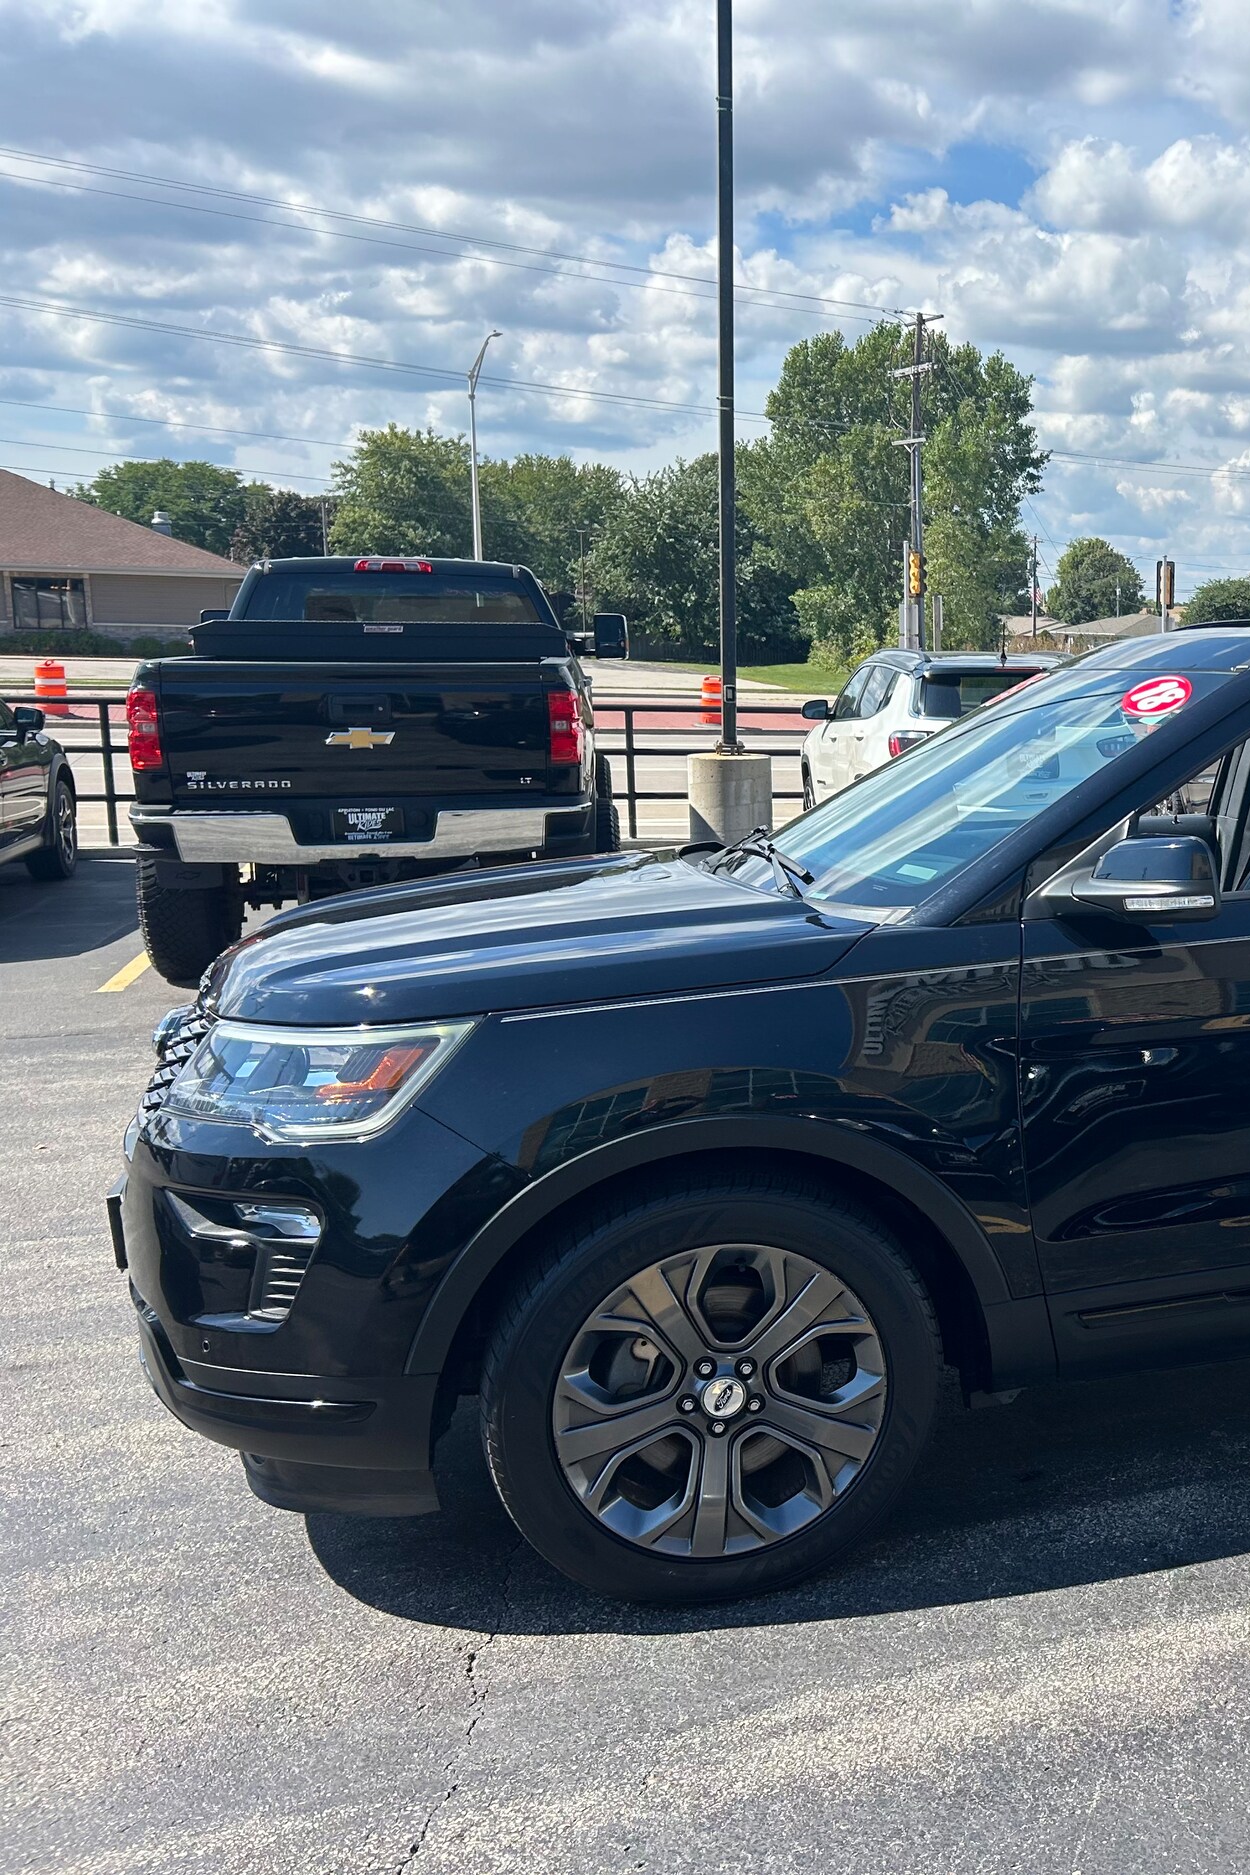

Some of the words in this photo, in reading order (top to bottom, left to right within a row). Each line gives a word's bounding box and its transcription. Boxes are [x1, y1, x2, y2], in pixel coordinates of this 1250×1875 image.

[1130, 681, 1186, 710] 18
[187, 781, 291, 789] SILVERADO
[348, 812, 386, 825] ULTIMATE
[716, 1388, 732, 1409] Ford
